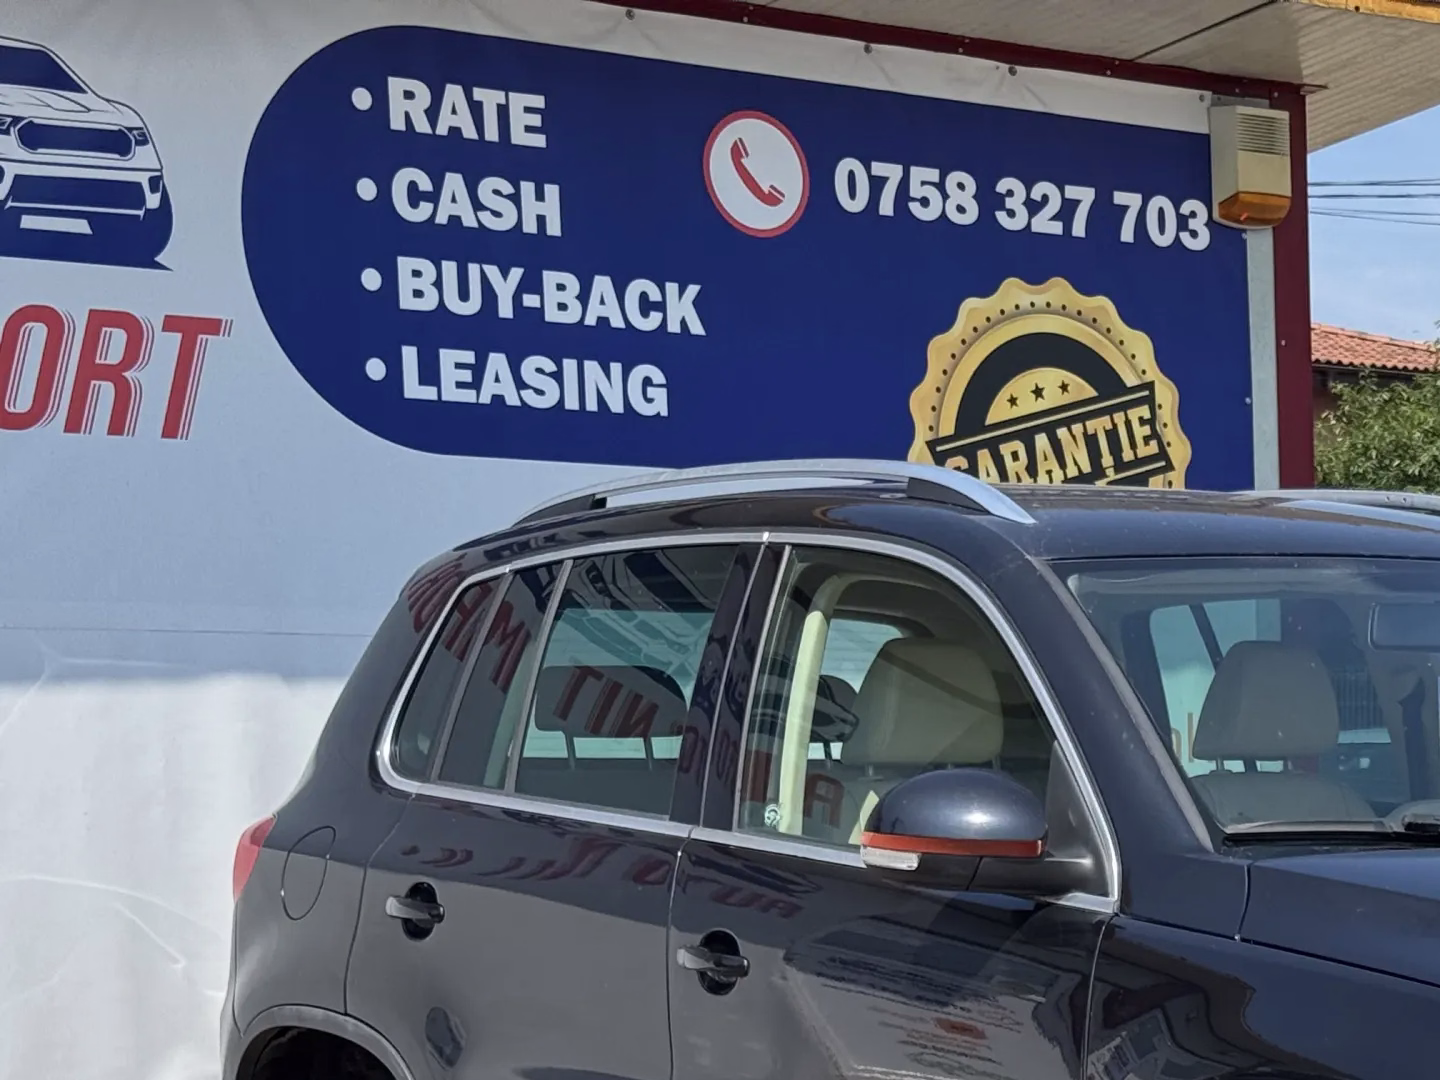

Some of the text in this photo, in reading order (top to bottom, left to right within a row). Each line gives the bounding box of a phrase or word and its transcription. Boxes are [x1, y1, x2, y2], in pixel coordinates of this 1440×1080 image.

[387, 76, 548, 148] RATE
[391, 167, 562, 237] CASH
[834, 157, 1211, 252] 0758 327 703
[398, 256, 706, 336] BUY-BACK
[401, 345, 669, 417] LEASING
